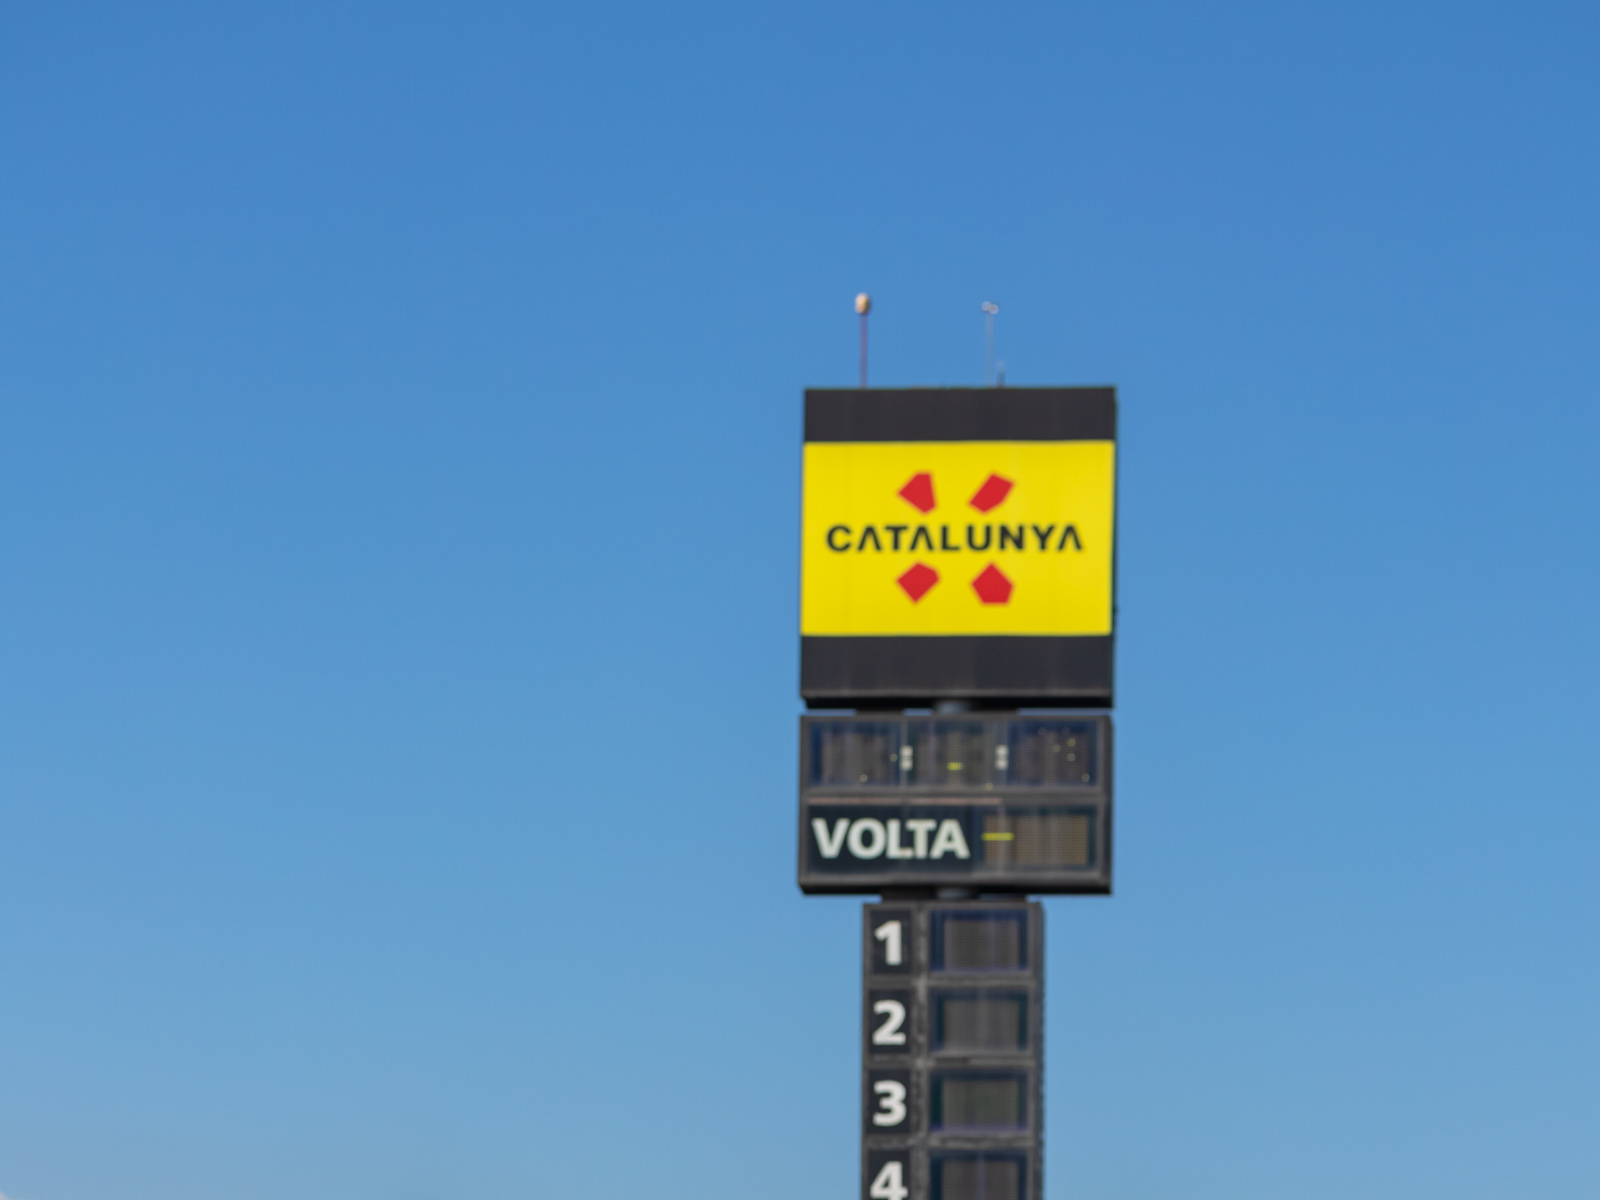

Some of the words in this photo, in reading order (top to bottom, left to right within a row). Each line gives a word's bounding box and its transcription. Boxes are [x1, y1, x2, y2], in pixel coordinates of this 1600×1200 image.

[826, 524, 1084, 553] CATALUNYA
[811, 817, 970, 860] VOLTA
[875, 922, 902, 965] 1
[873, 1001, 905, 1045] 2
[873, 1081, 905, 1125] 3
